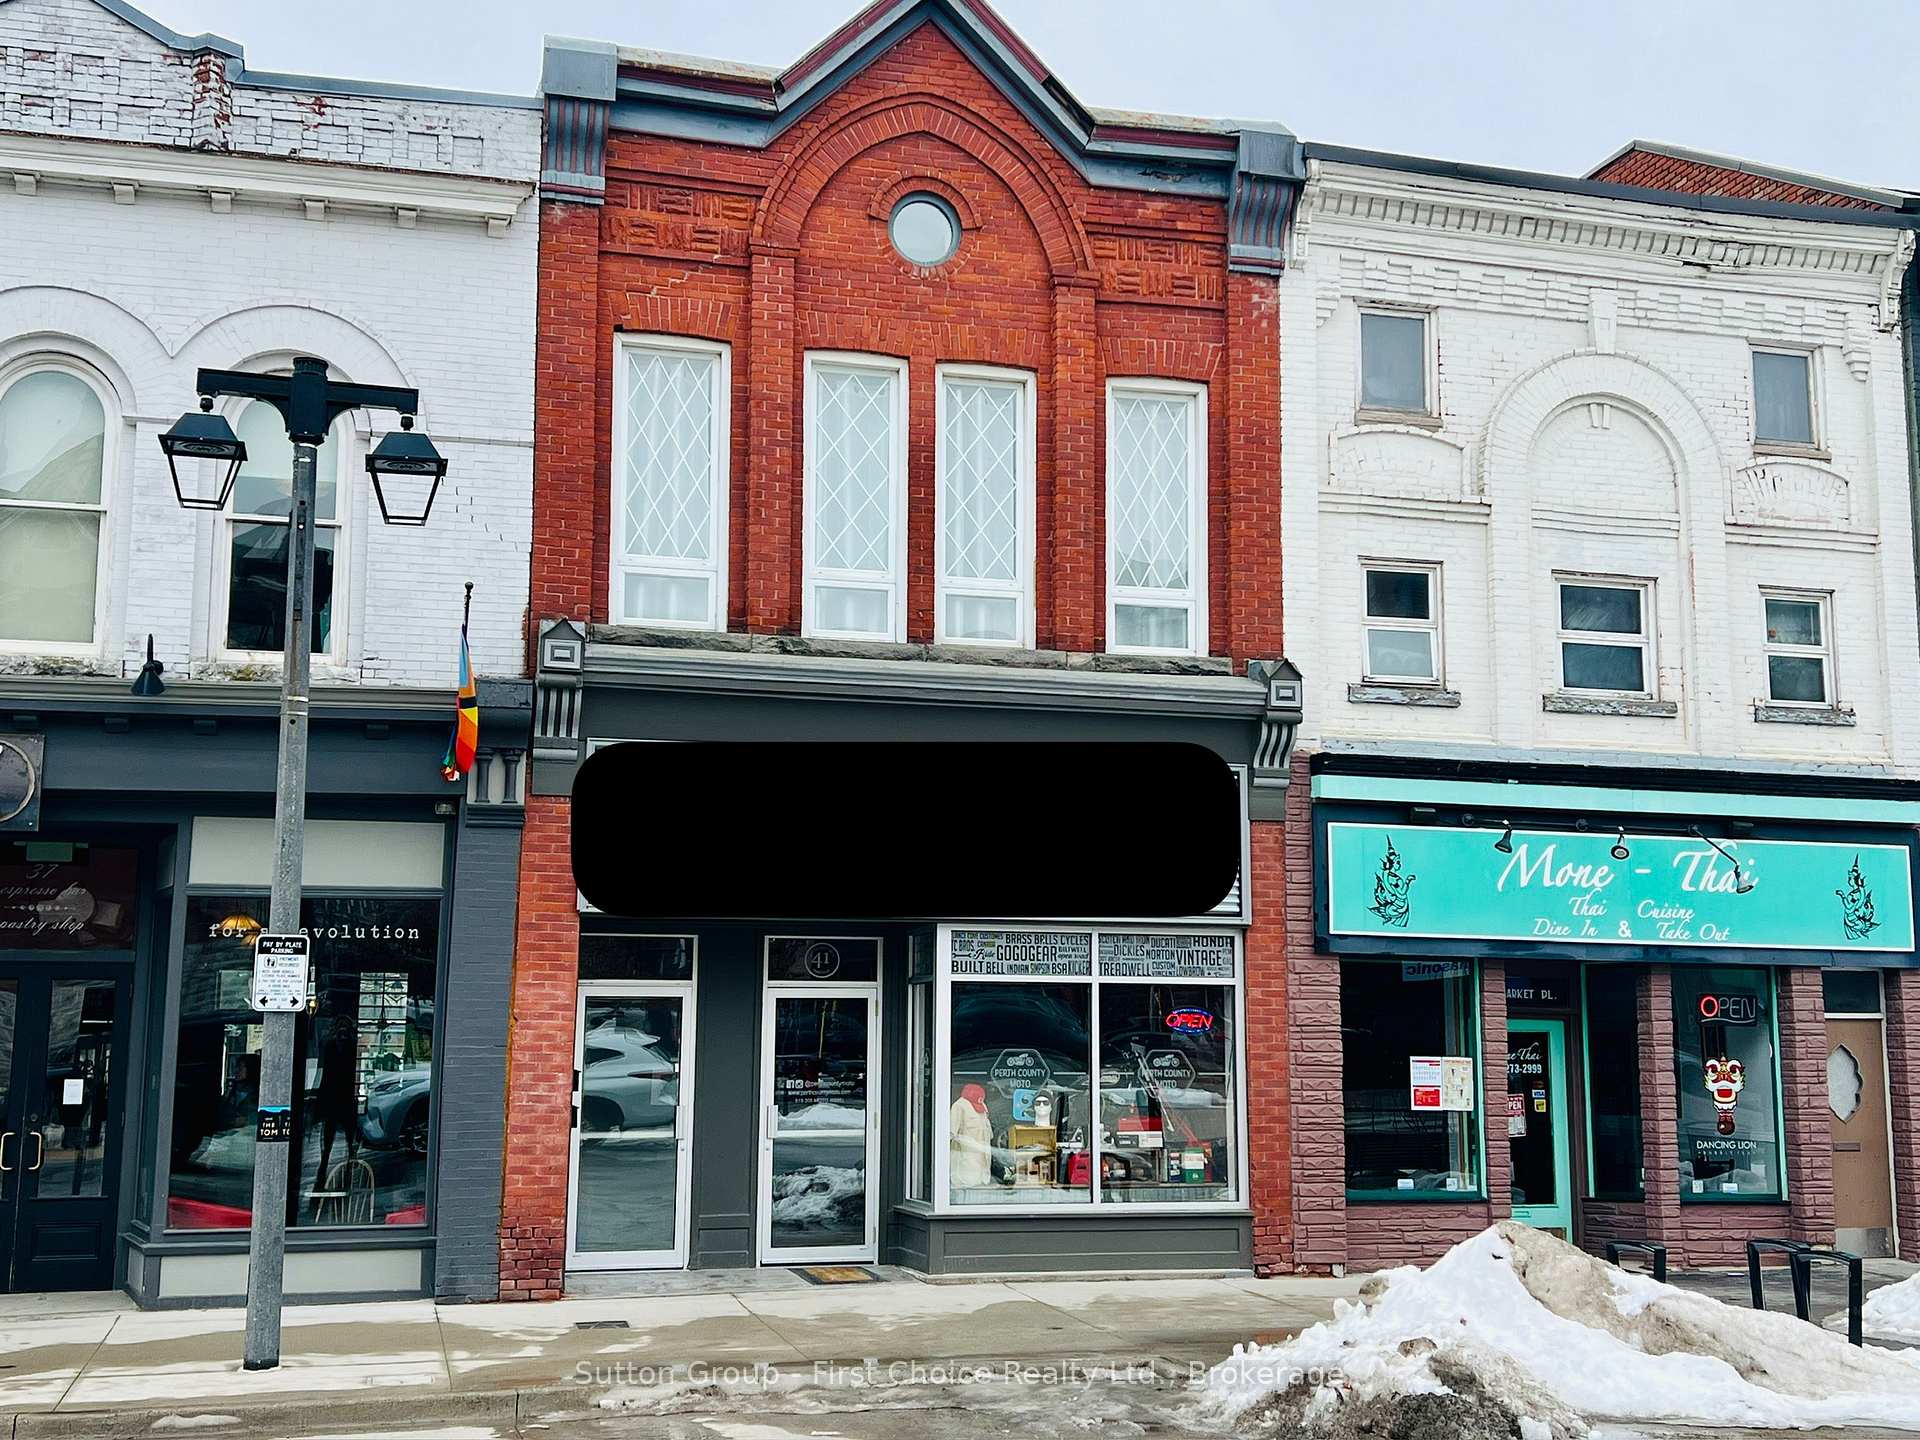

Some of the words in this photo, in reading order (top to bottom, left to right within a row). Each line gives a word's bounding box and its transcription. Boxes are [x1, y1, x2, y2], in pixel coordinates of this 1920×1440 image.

[26, 863, 59, 879] 37
[1497, 843, 1615, 892] Mone
[1672, 840, 1760, 893] Thai
[0, 887, 58, 899] espresso
[60, 881, 87, 896] bar
[1568, 887, 1608, 916] Thai
[1637, 899, 1695, 920] Cuisine
[49, 915, 85, 934] shop
[209, 923, 247, 937] for
[298, 925, 419, 939] evolution
[1533, 918, 1571, 936] Dine
[1580, 919, 1598, 937] In
[1618, 920, 1632, 938] &
[1656, 918, 1692, 940] Take
[1700, 923, 1731, 942] Out
[1005, 934, 1032, 944] BRASS
[1060, 935, 1089, 946] CYCLES
[1151, 938, 1176, 948] DUCATI
[1193, 937, 1232, 948] HONDA
[996, 945, 1057, 962] GOGOGEAR
[1113, 945, 1145, 956] DICKIES
[1146, 949, 1176, 960] NORTON
[811, 952, 829, 968] 41
[1176, 950, 1222, 966] VINTAGE
[951, 961, 983, 973] BUILT
[985, 962, 1005, 975] BELL
[1006, 964, 1029, 974] INDIAN
[1052, 963, 1067, 974] BSA
[1099, 962, 1151, 976] TREADWELL
[1152, 961, 1176, 970] CUSTOM
[1506, 989, 1534, 999] ARKET
[1700, 995, 1756, 1019] OPEN
[1166, 1014, 1213, 1029] OPEN
[994, 1069, 1016, 1077] PERTH
[1017, 1069, 1046, 1077] COUNTY
[1163, 1069, 1191, 1078] COUNTY
[1009, 1079, 1031, 1088] MOTO
[1508, 1101, 1522, 1110] PEN
[1696, 1141, 1736, 1150] DANCING
[1738, 1141, 1757, 1150] LION
